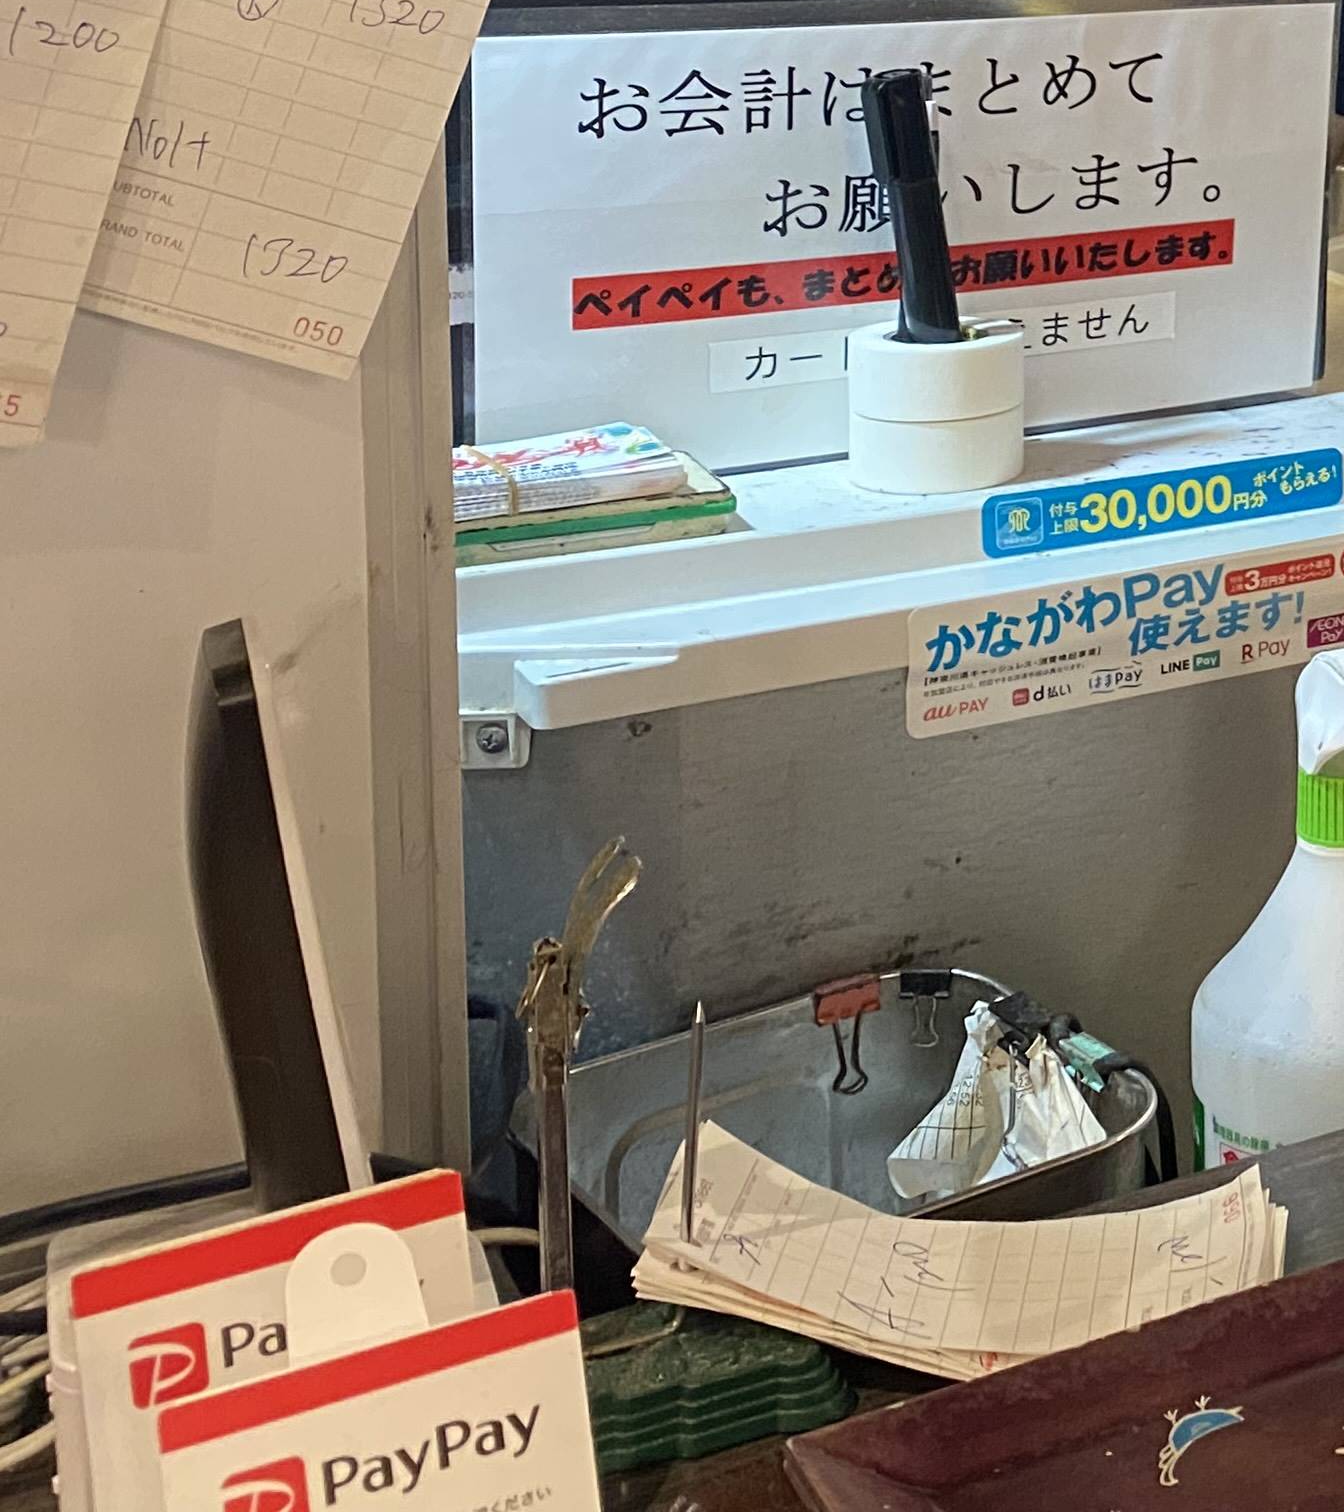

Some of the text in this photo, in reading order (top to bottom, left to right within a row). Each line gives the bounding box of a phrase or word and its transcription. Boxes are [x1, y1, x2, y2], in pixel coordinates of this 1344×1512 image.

[8, 6, 120, 56] 1200
[113, 180, 175, 207] UBTOTAL
[100, 218, 185, 253] RAND TOTAL
[242, 234, 349, 284] 1320
[572, 231, 1230, 318] ペイペイも、まとめお願いいたします。
[293, 316, 344, 346] 050
[0, 394, 22, 417] 5
[1253, 461, 1304, 488] ポイント
[1280, 464, 1338, 495] もらえる!
[1049, 501, 1077, 518] 付与
[1080, 475, 1267, 534] 30,000円分
[926, 564, 1225, 672] かながわPay
[1128, 591, 1305, 657] 使えます!
[1241, 639, 1291, 663] R Pay
[1320, 630, 1344, 643] Pay
[1160, 654, 1219, 675] LINE Pay
[1033, 684, 1071, 702] d払い
[922, 698, 988, 722] au PAY
[321, 1405, 540, 1506] PayPay
